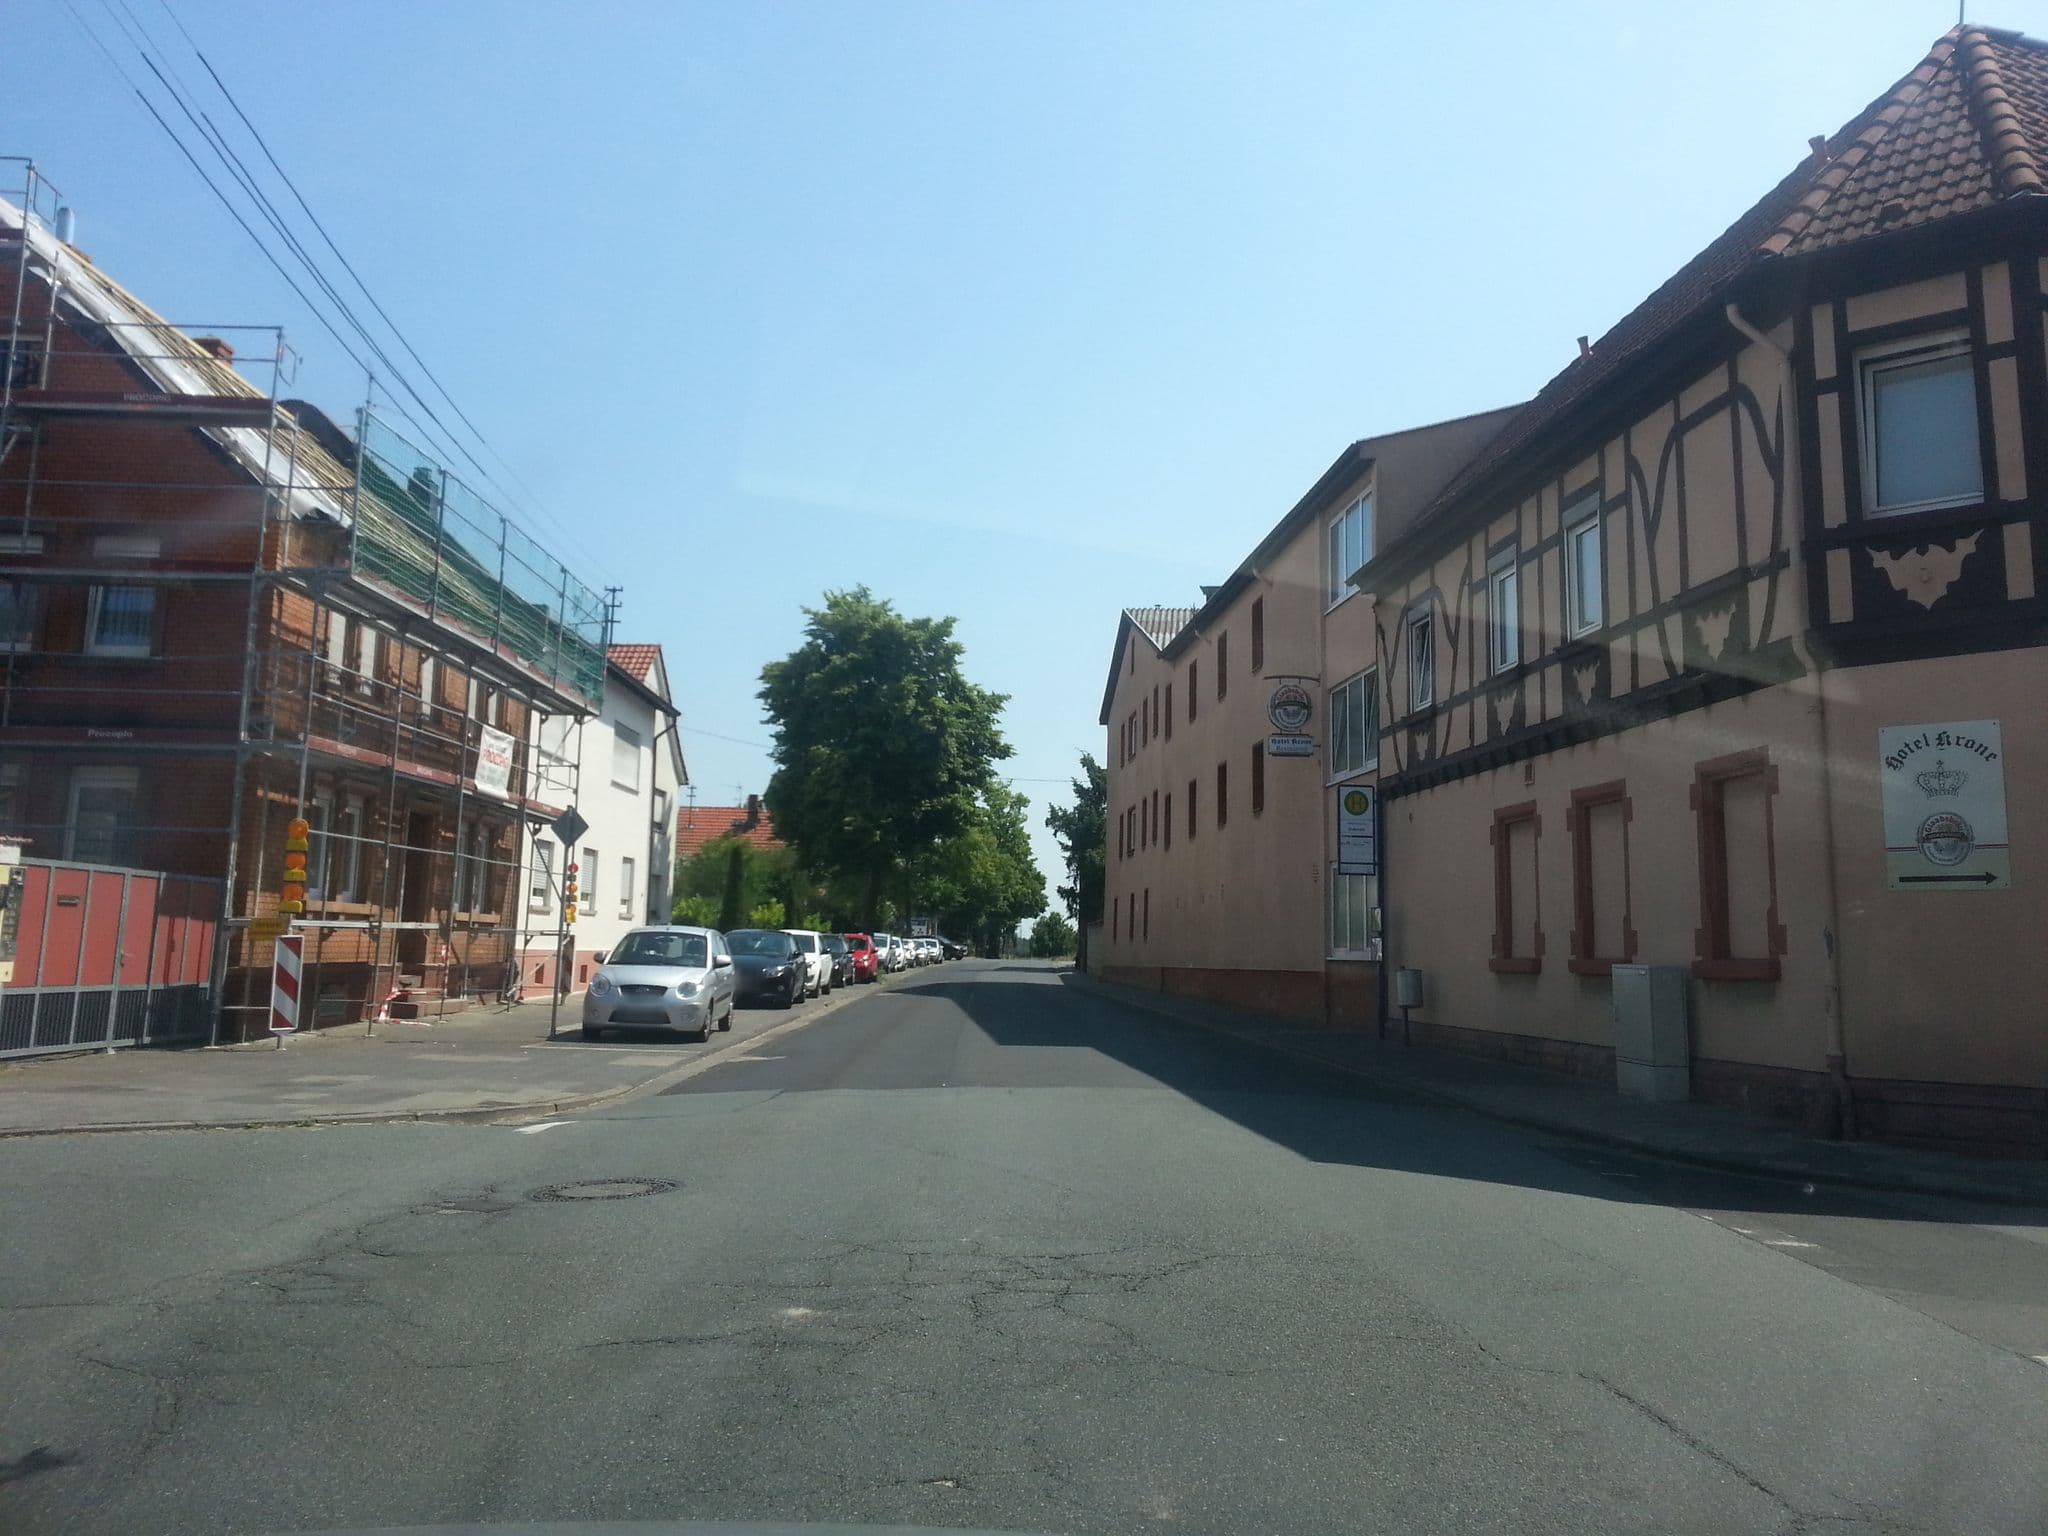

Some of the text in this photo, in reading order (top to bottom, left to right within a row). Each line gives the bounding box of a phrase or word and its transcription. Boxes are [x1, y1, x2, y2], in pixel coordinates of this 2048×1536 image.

[1885, 731, 1998, 771] Hotel Krone
[1924, 815, 1964, 832] Glaabsb
